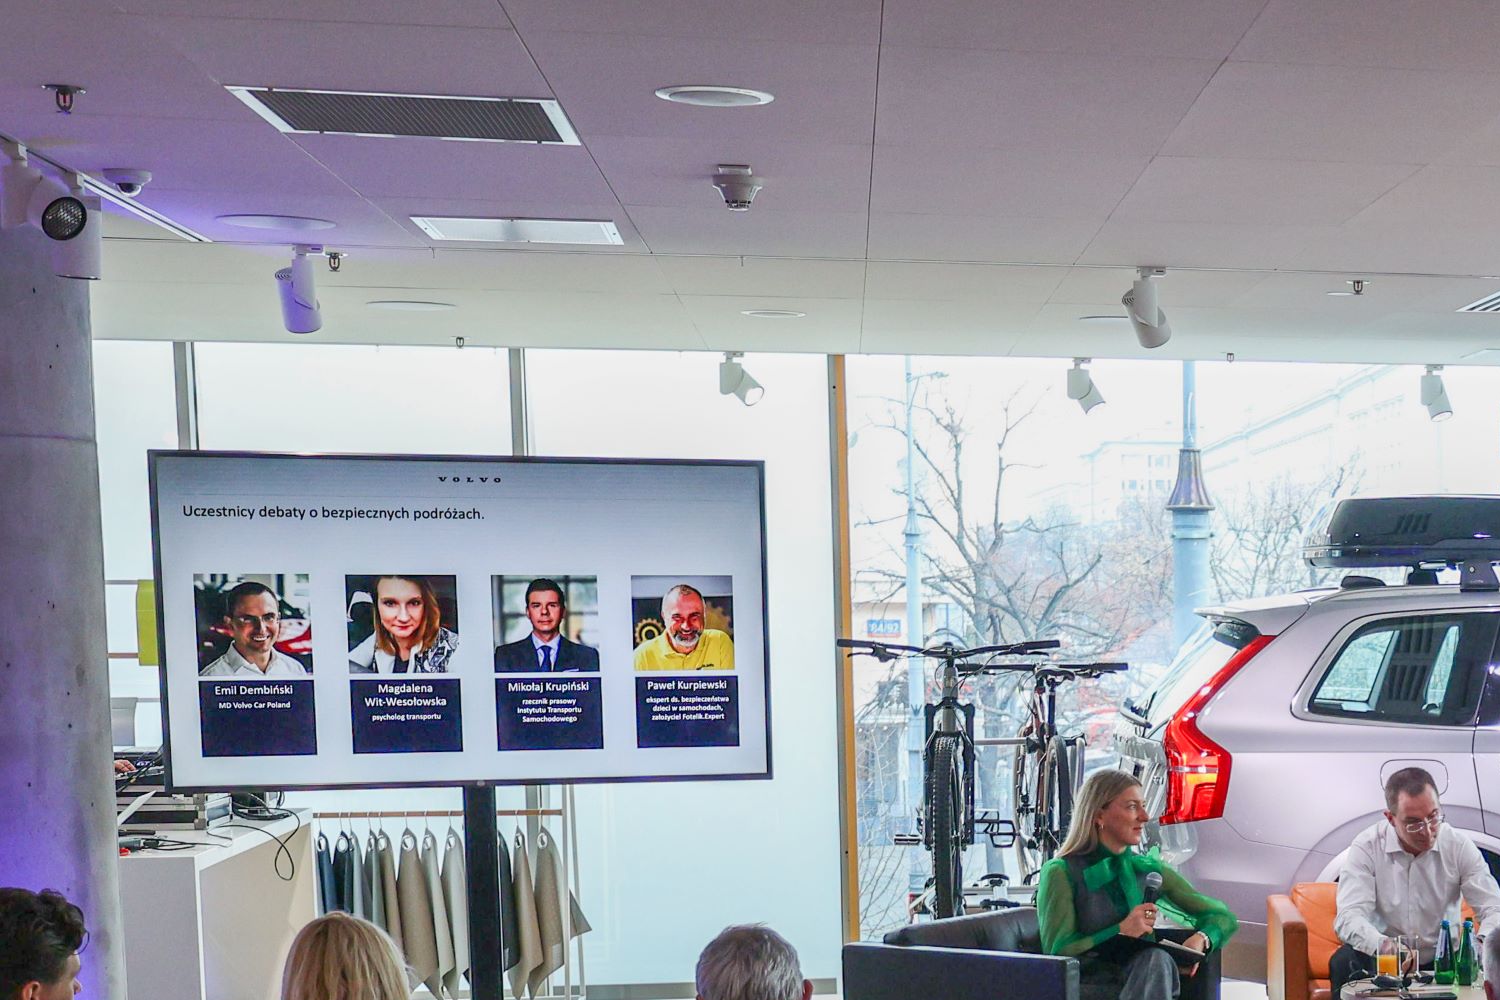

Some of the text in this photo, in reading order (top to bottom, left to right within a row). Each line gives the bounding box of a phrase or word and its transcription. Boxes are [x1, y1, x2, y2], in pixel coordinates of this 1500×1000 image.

[182, 505, 485, 521] Uczestnicy debaty o bezpiecznych podróżach.
[215, 684, 293, 695] Emil Dembiński
[378, 683, 434, 695] Magdalena
[508, 681, 590, 693] Mikołaj Krupiński
[647, 680, 728, 691] Paweł Kurpiewski
[364, 696, 447, 707] Wit-Wesołowska
[522, 697, 577, 706] rzecznik prasowy
[646, 696, 670, 704] ekspert
[681, 695, 730, 703] bezpieczeństwa
[232, 701, 253, 709] Volvo
[266, 701, 291, 709] Poland
[652, 704, 671, 712] dzieci
[678, 704, 724, 713] samochodach,
[517, 706, 583, 715] Instytutu Transportu
[371, 713, 441, 722] psycholog transportu
[522, 715, 578, 723] Samochodowego
